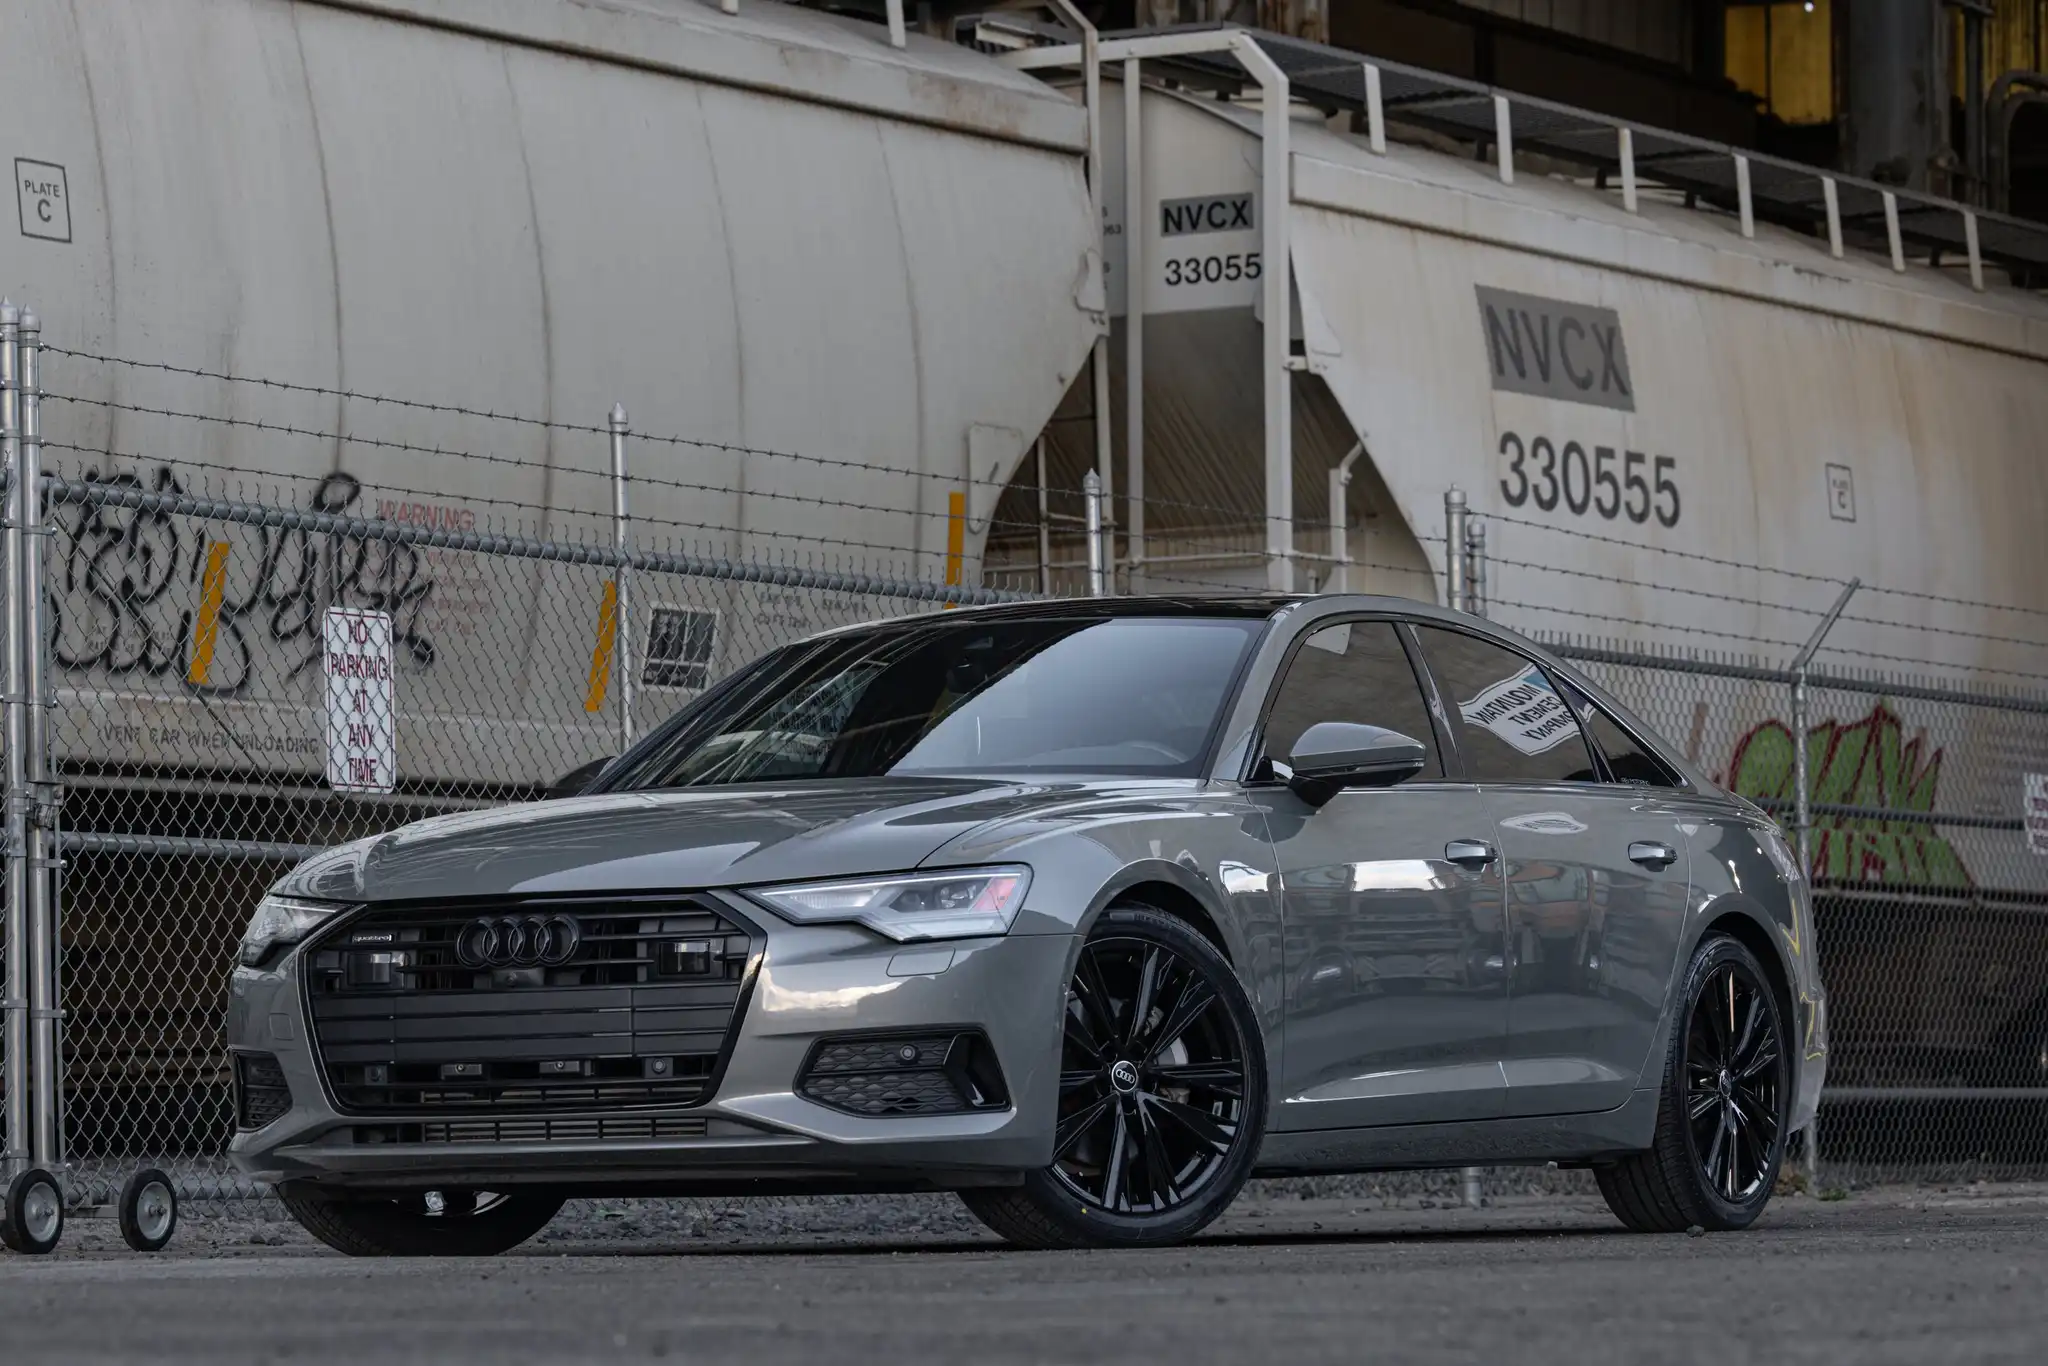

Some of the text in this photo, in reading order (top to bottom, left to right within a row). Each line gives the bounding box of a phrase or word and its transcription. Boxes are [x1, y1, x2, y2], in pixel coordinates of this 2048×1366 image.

[24, 179, 60, 198] PLATE
[37, 198, 52, 223] C
[1163, 199, 1249, 233] NVCX
[1164, 252, 1262, 286] 33055
[1485, 303, 1629, 396] NVCX
[1499, 431, 1681, 528] 330555
[380, 499, 475, 533] WARNNG
[348, 619, 369, 645] NO
[331, 652, 388, 680] PARKING
[353, 688, 368, 713] AT
[348, 723, 374, 748] ANY
[349, 757, 377, 783] TIME
